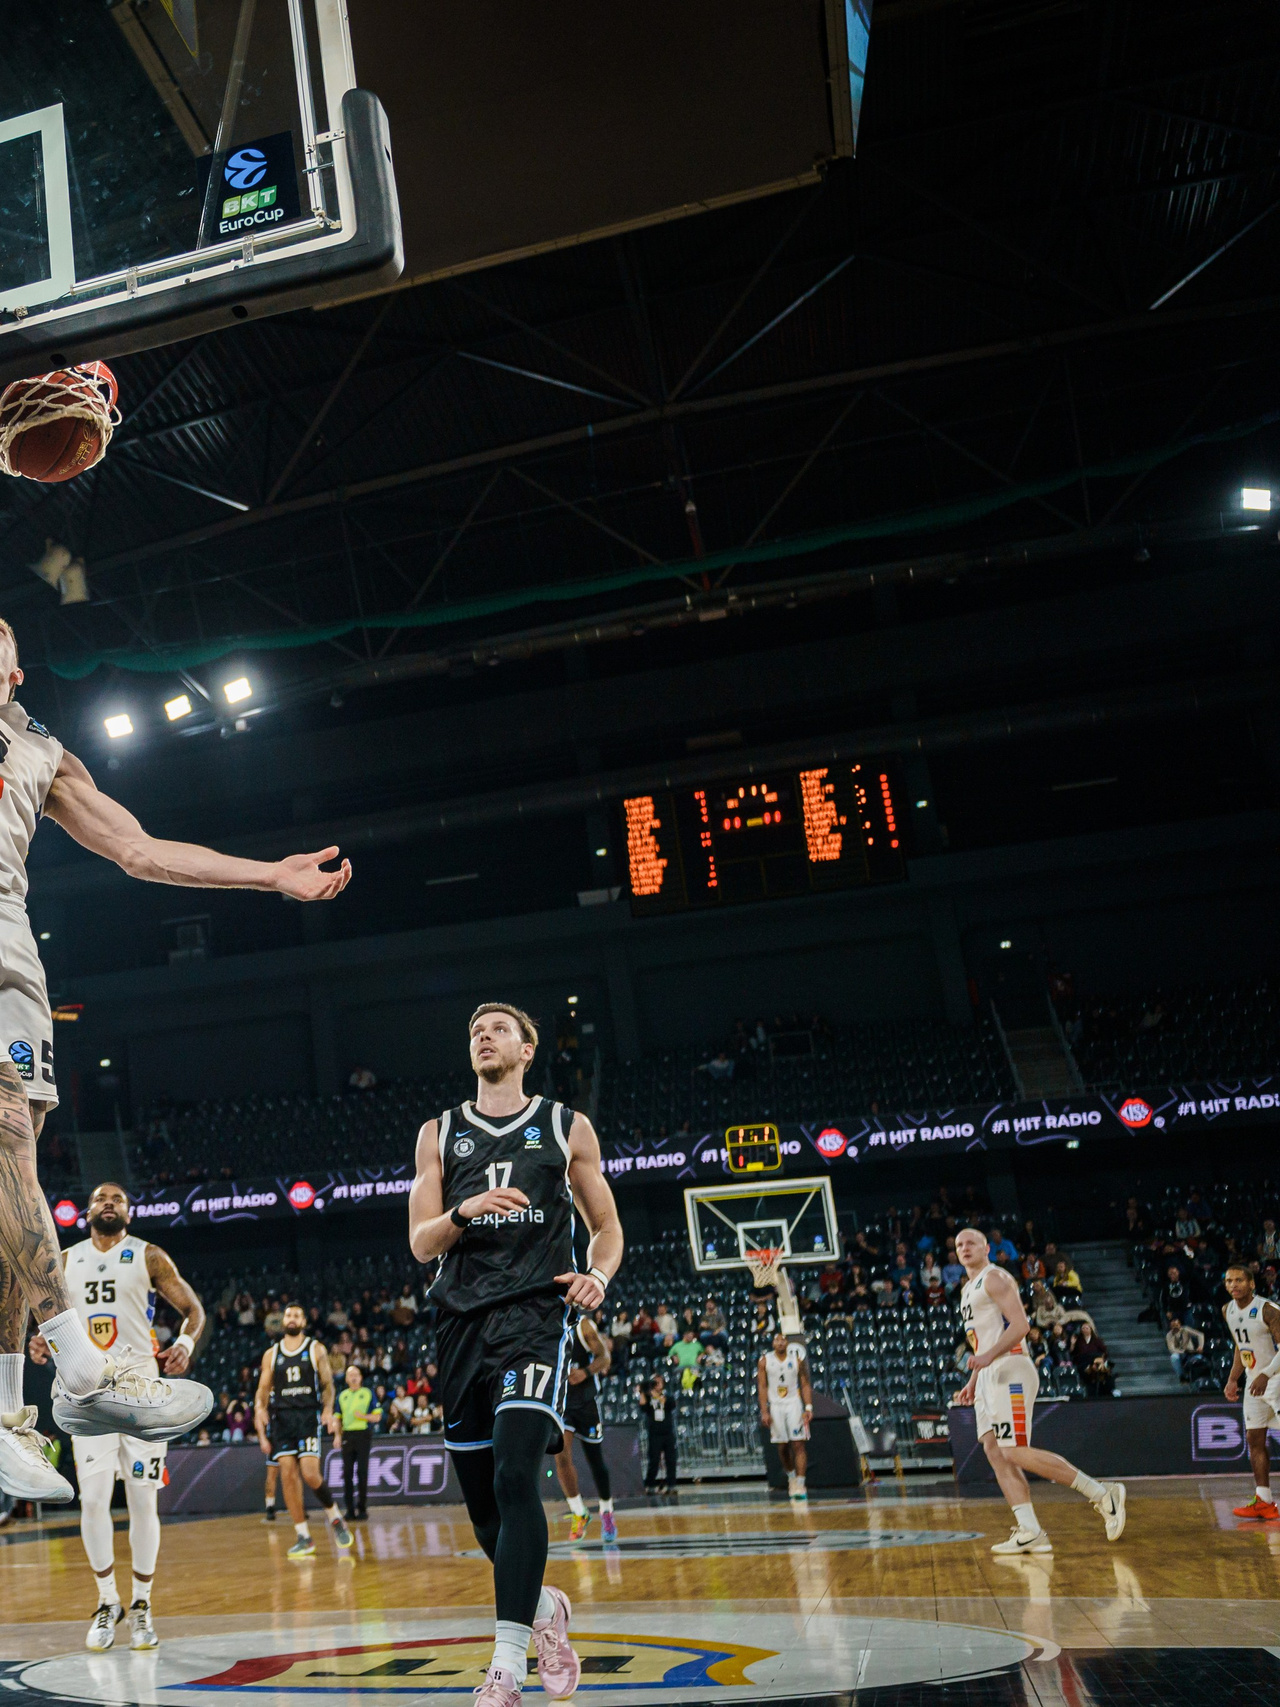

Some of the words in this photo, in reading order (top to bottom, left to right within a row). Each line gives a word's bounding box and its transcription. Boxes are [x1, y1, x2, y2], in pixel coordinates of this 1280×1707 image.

[223, 187, 276, 217] BKT
[219, 208, 284, 234] EuroCup
[1177, 1101, 1197, 1116] #1
[1200, 1098, 1230, 1114] HIT
[992, 1119, 1010, 1134] #1
[1013, 1116, 1042, 1132] HIT
[1044, 1110, 1102, 1129] RADIO
[869, 1132, 887, 1146] #1
[889, 1129, 917, 1144] HIT
[920, 1123, 975, 1141] RADIO
[608, 1157, 634, 1173] HIT
[636, 1152, 686, 1170] RADIO
[701, 1149, 718, 1163] #1
[485, 1161, 513, 1191] 17
[332, 1185, 348, 1199] #1
[350, 1182, 375, 1198] HIT
[136, 1201, 181, 1218] RADIO
[191, 1199, 207, 1213] #1
[208, 1196, 233, 1212] HIT
[232, 1192, 278, 1208] RADIO
[467, 1205, 545, 1229] experia
[85, 1280, 116, 1305] 35
[93, 1322, 112, 1335] BT
[1235, 1328, 1251, 1344] 11
[286, 1366, 301, 1383] 13
[523, 1363, 552, 1399] 17
